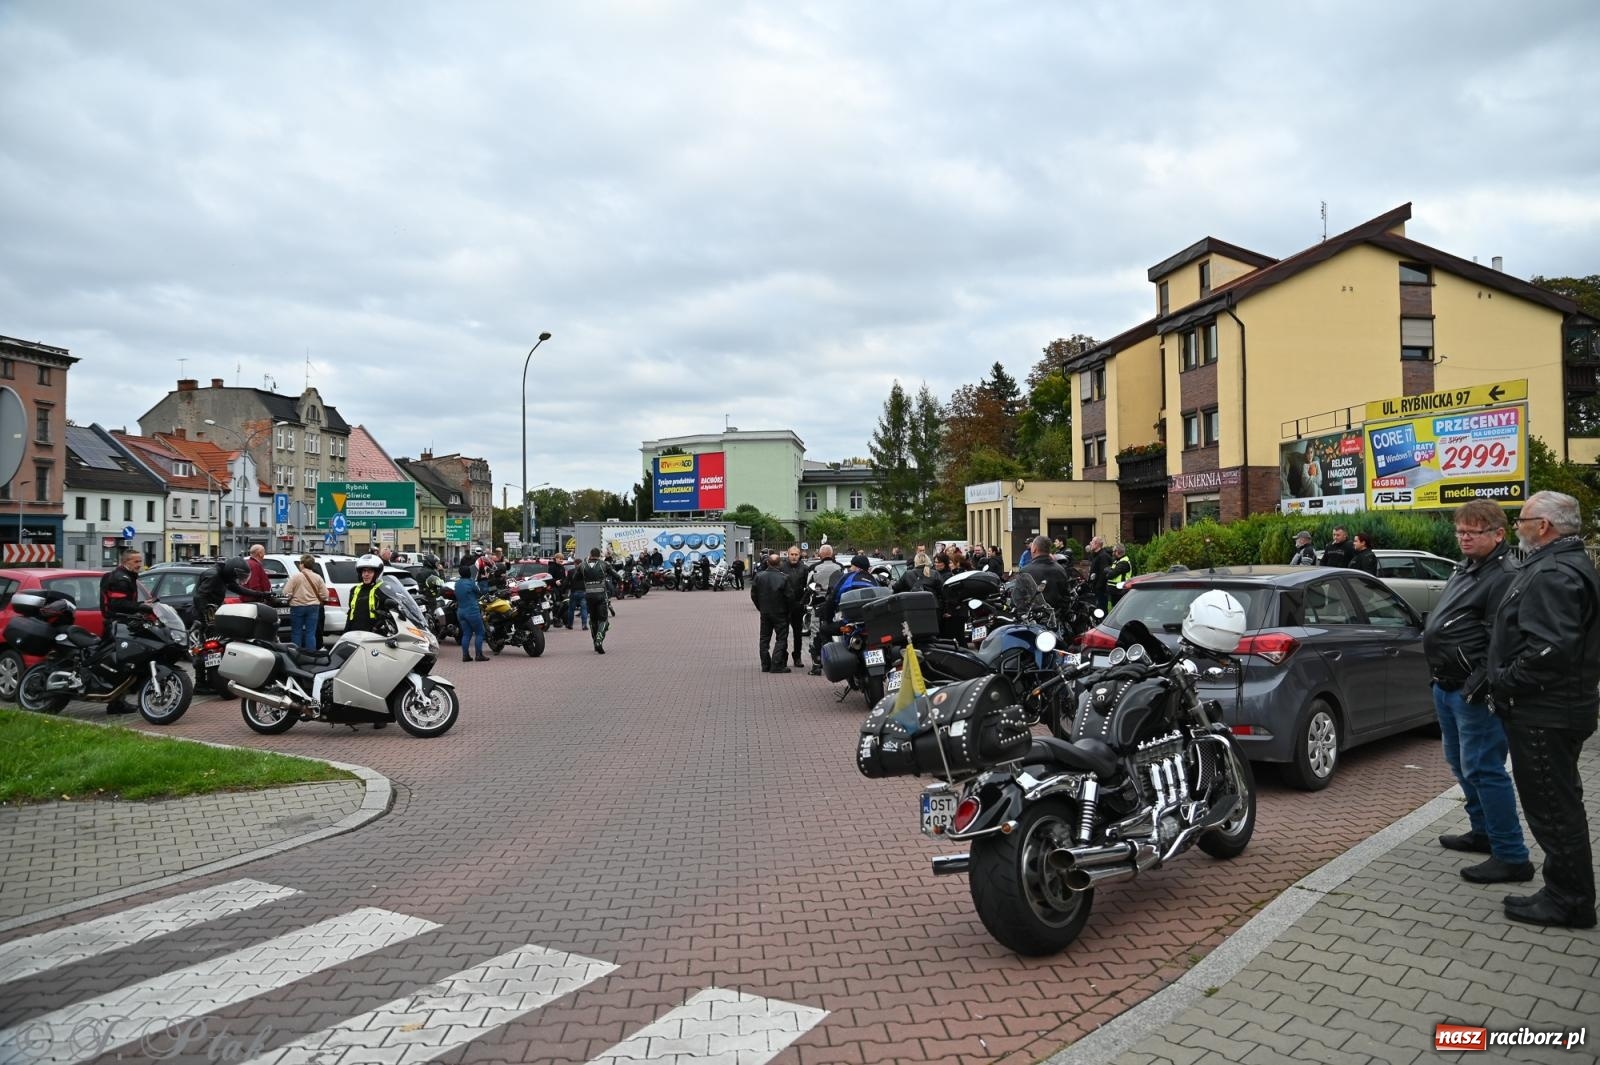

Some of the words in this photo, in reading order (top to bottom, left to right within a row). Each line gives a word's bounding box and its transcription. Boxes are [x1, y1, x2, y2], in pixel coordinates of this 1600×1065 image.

[1383, 402, 1398, 415] UL.
[1401, 393, 1453, 413] RYBNICKA
[1456, 390, 1470, 405] 97
[1435, 411, 1516, 433] PRZECENY!
[1473, 430, 1483, 438] NA
[1483, 427, 1516, 437] URODZINY
[1373, 430, 1403, 450] CORE
[1404, 428, 1413, 443] i7
[1386, 453, 1408, 463] Windows
[1414, 450, 1428, 462] 0%
[1331, 457, 1353, 468] RELAKS
[1330, 467, 1357, 478] NAGRODY
[1390, 478, 1404, 486] RAM
[1374, 491, 1412, 504] ASUS
[1444, 486, 1509, 499] mediaexpert
[278, 496, 286, 514] P
[931, 799, 952, 811] OST
